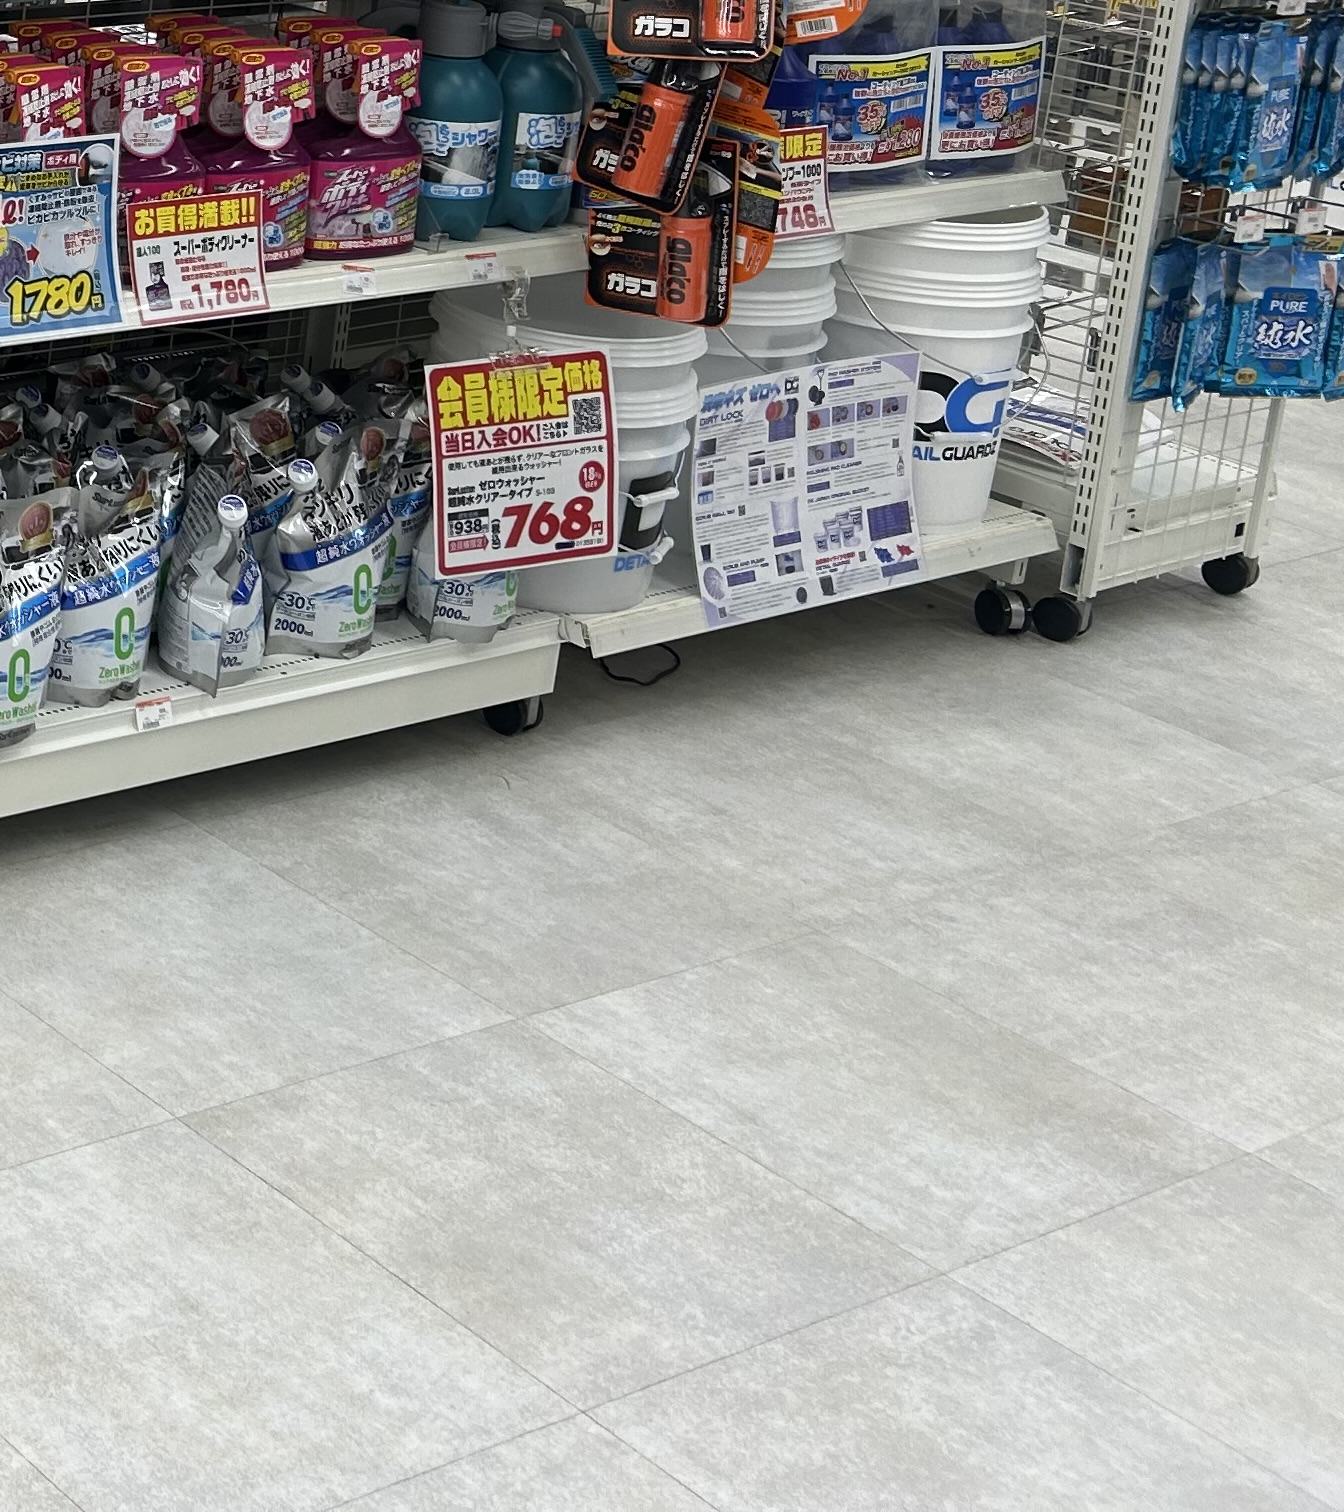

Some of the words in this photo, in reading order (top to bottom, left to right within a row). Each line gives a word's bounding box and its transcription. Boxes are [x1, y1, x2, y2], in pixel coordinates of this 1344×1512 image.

[633, 15, 690, 39] ガラコ
[134, 196, 255, 236] お買得満載!!
[191, 277, 251, 310] 1,780
[444, 425, 541, 454] 当日入会OK!
[454, 519, 482, 535] 938
[501, 495, 594, 549] 768
[591, 521, 603, 536] 円
